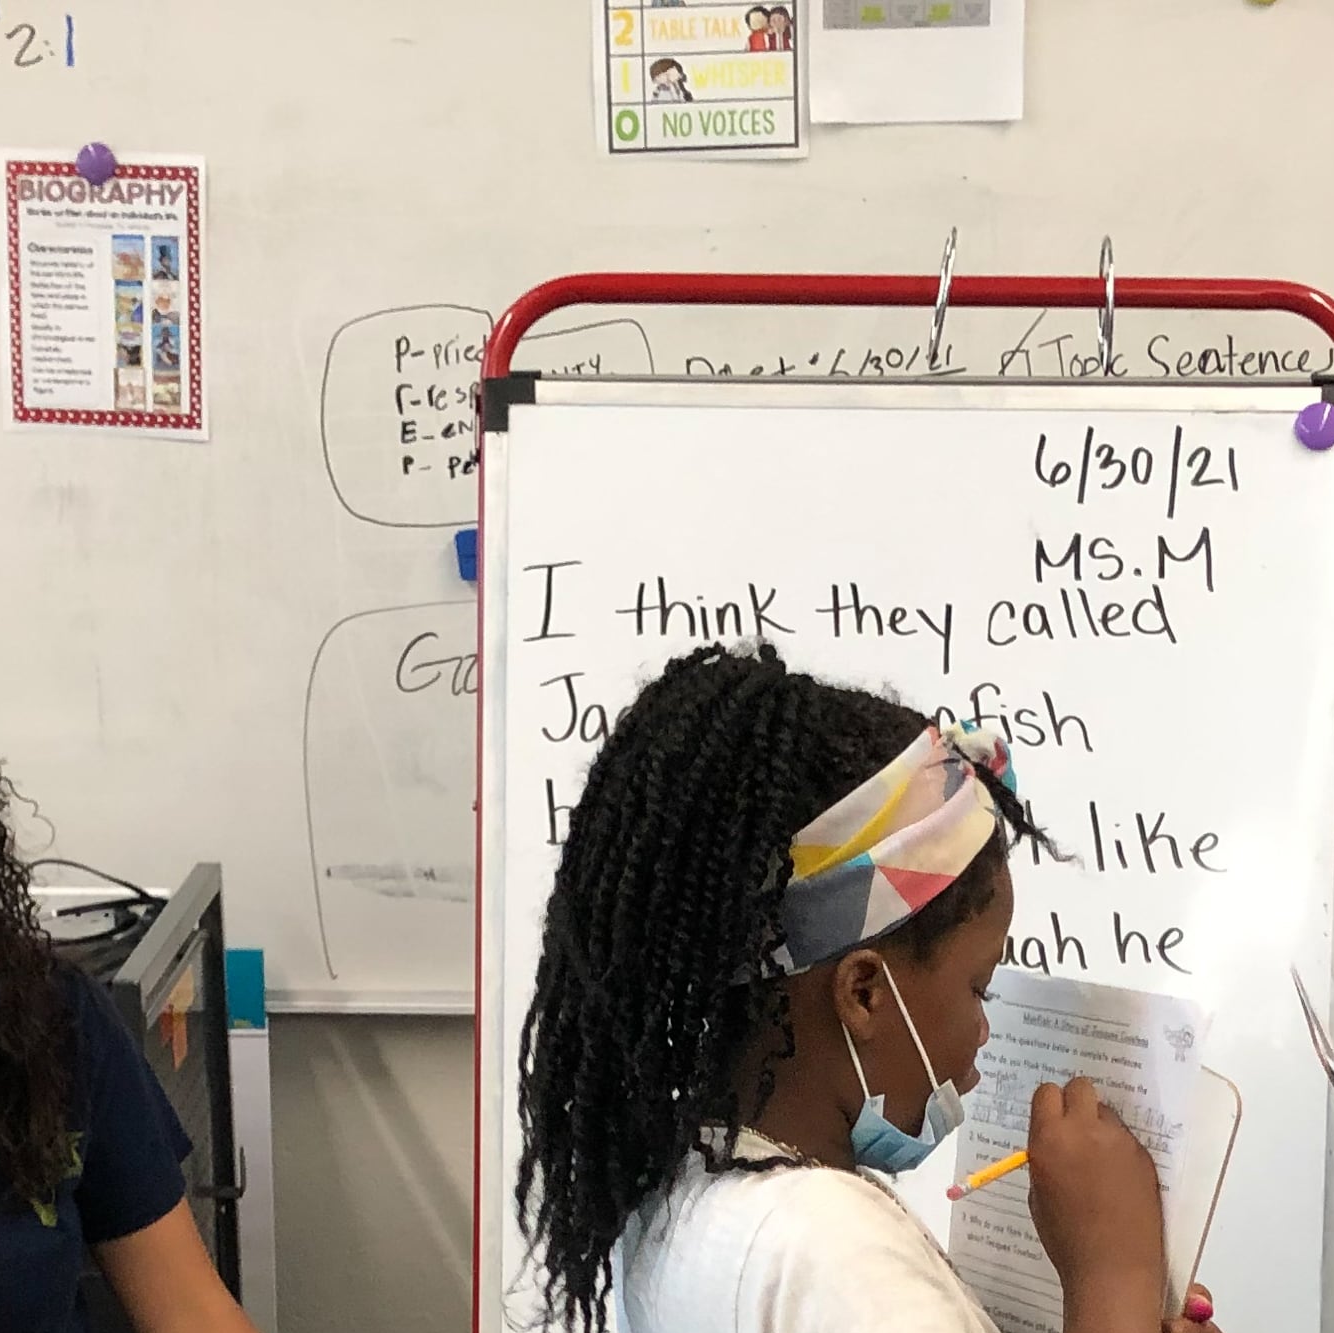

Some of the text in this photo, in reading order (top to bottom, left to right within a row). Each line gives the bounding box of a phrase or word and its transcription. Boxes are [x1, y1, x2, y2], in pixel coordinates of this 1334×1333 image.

[612, 8, 741, 46] 2 TABLE TALK
[662, 112, 692, 137] NO
[698, 109, 776, 137] VOICES
[17, 179, 183, 206] BIOGRAPHY
[1035, 425, 1239, 519] 6/30/21
[523, 561, 1177, 674] I think they called
[540, 671, 633, 743] Ja
[1089, 801, 1228, 873] like
[1113, 911, 1193, 975] he
